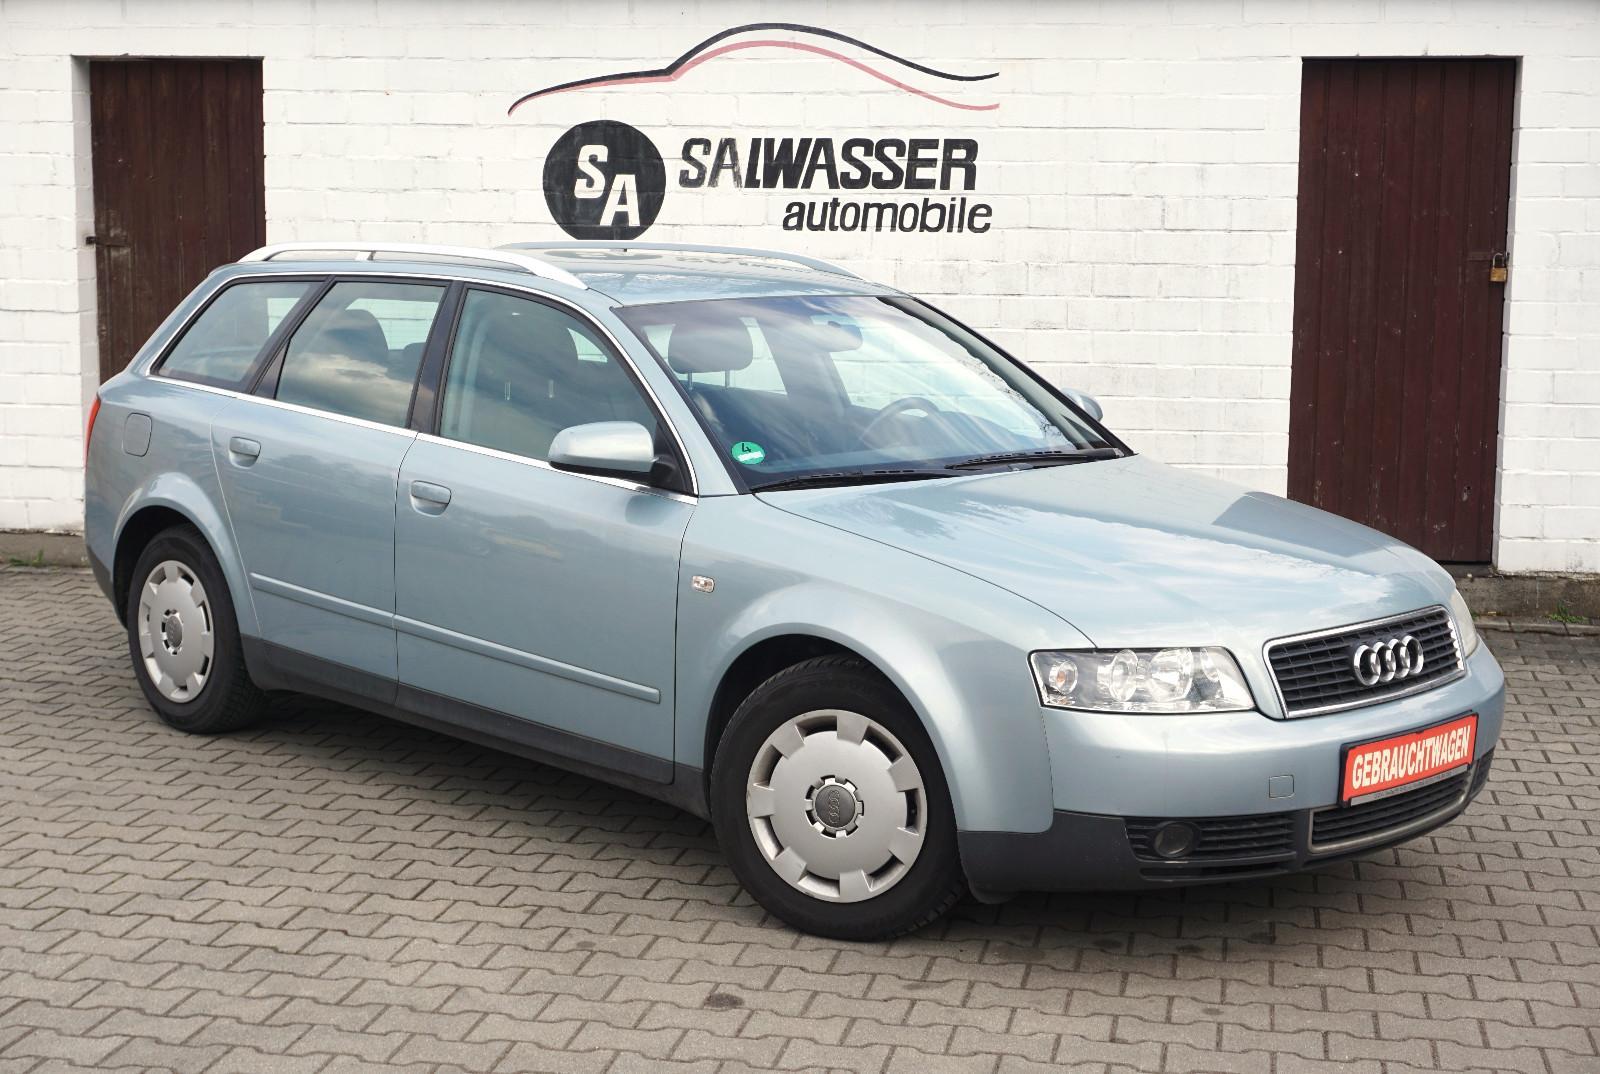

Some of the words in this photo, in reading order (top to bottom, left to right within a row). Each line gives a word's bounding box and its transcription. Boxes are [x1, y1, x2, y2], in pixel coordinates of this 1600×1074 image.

[574, 144, 640, 227] SA
[678, 137, 979, 190] SALWASSER
[783, 197, 993, 234] automobile
[742, 443, 751, 452] 4
[1352, 725, 1471, 790] GEBRAUCHTWAGEN
